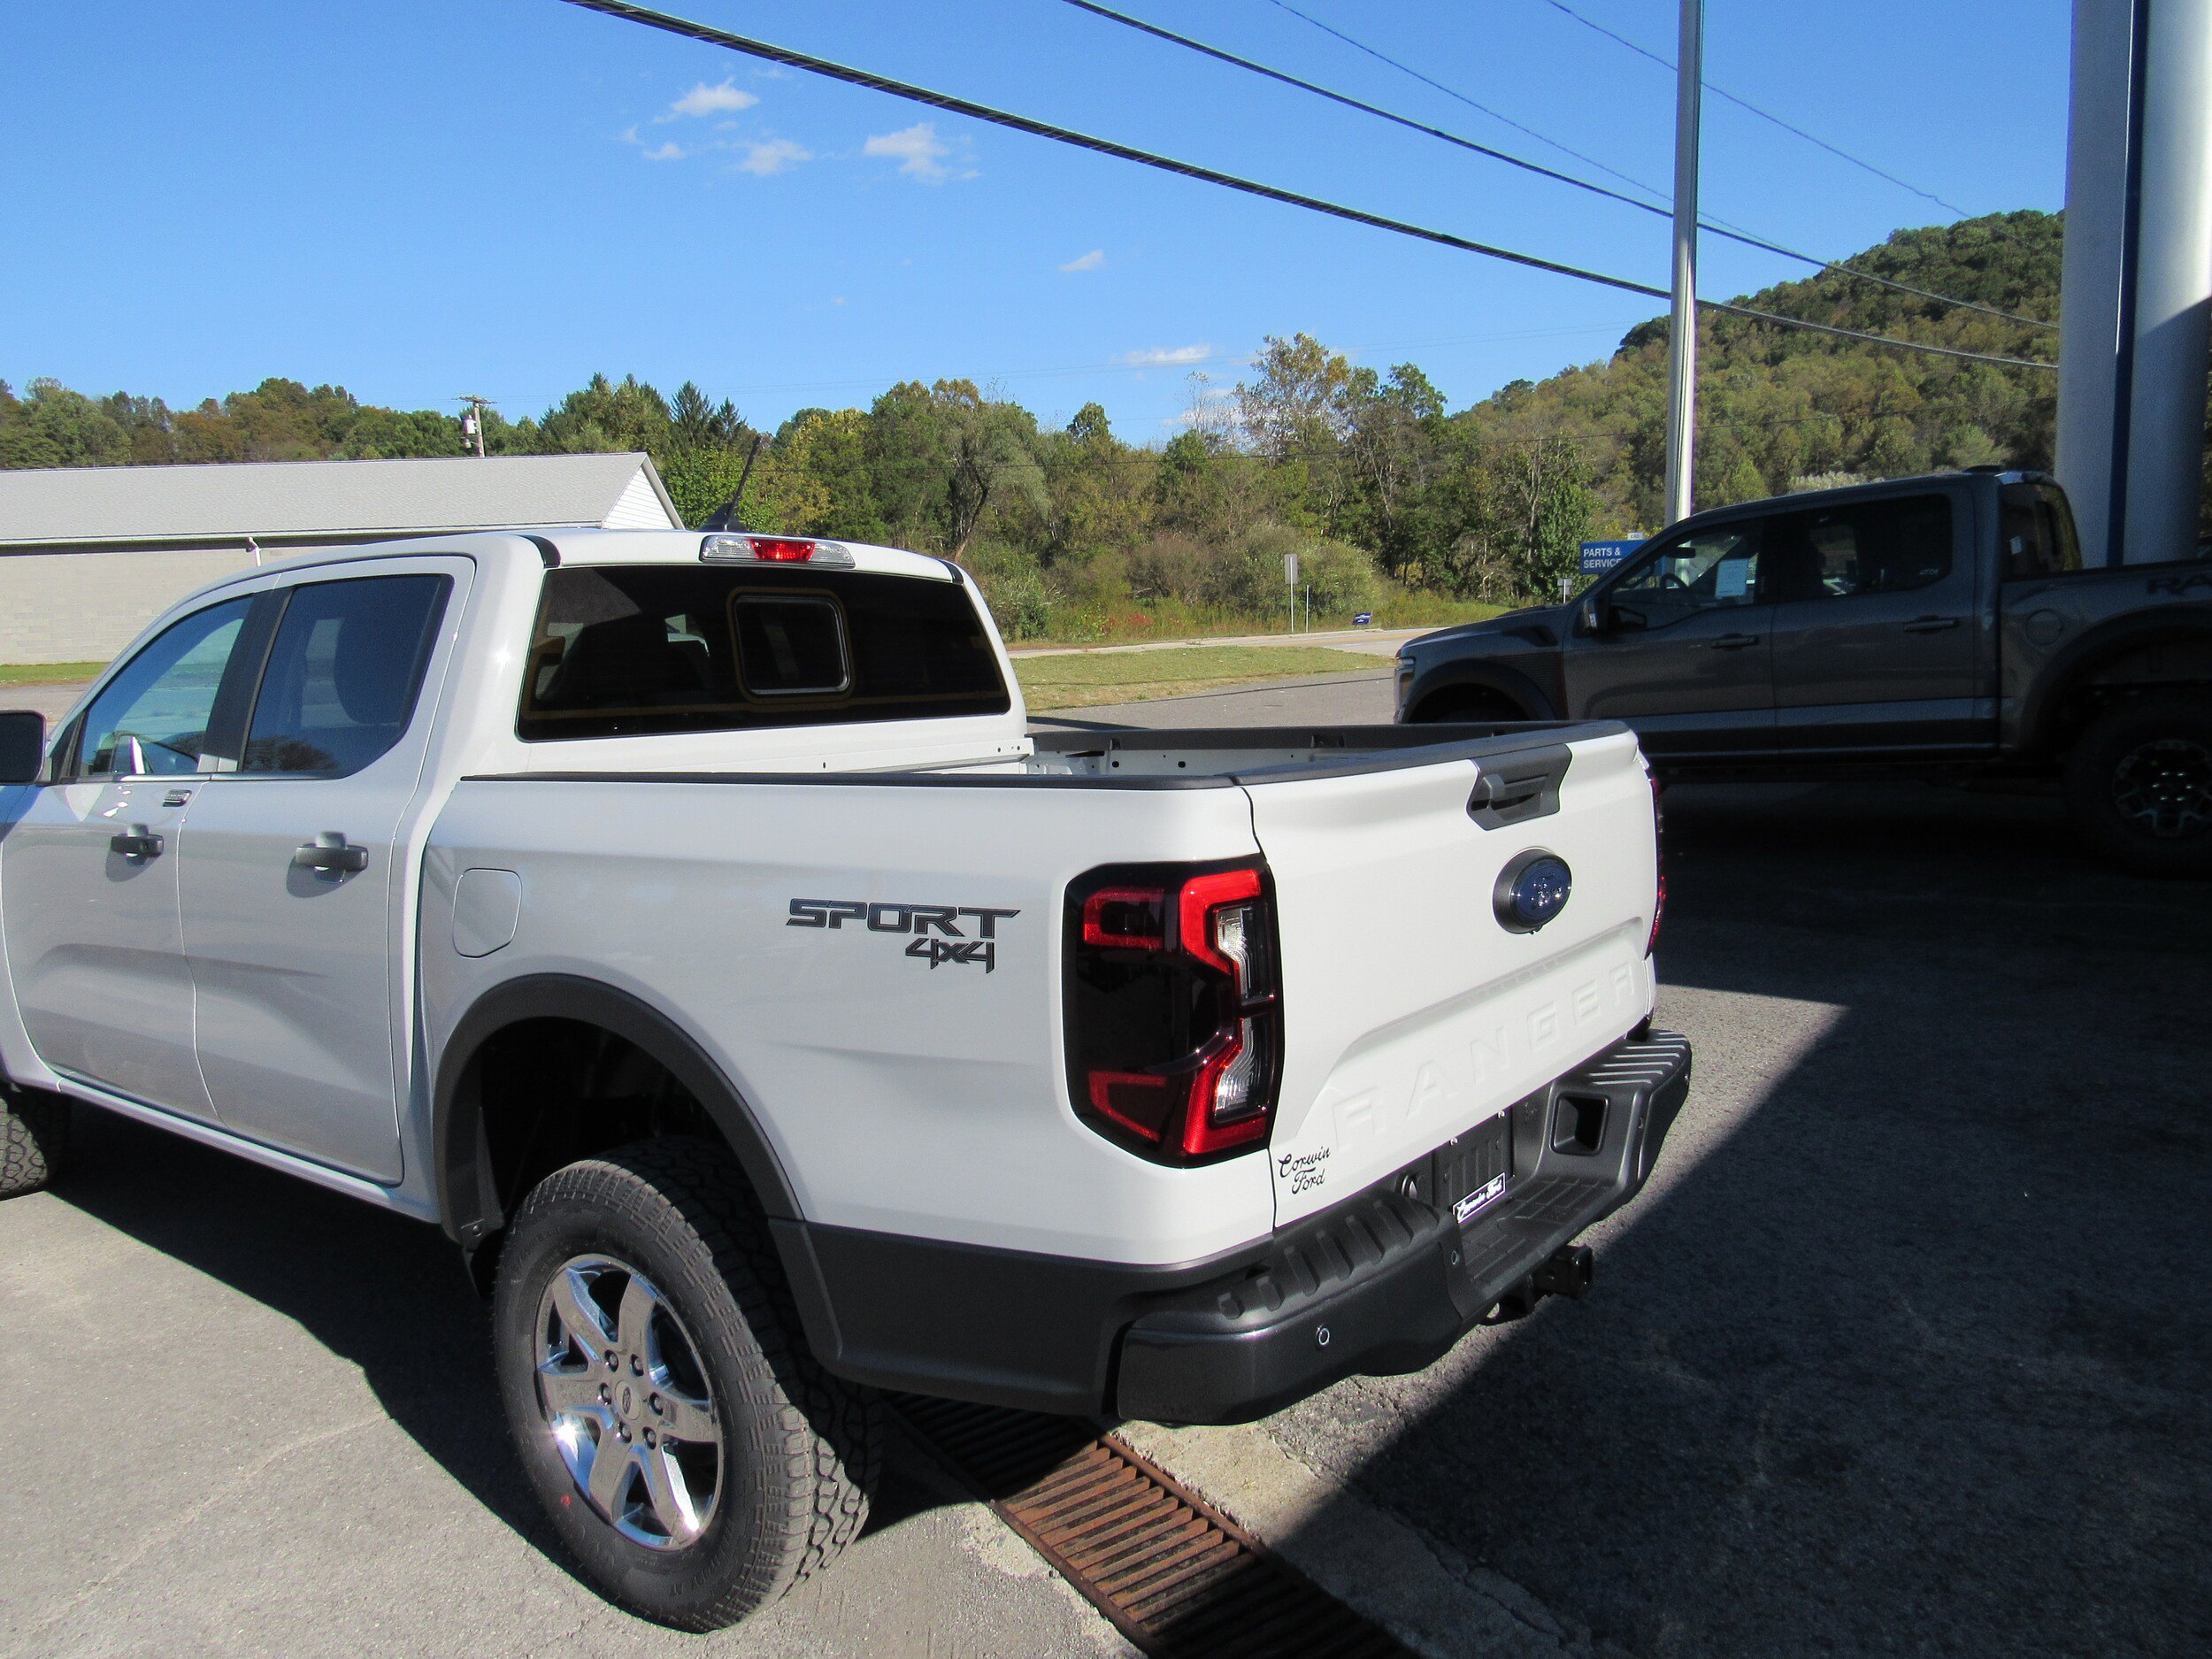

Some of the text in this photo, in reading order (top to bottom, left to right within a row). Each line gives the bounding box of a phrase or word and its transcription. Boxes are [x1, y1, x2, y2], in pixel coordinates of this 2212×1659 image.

[1584, 547, 1621, 557] PARTS &
[787, 898, 1021, 939] SPORT
[1332, 959, 1635, 1155] RANGER
[1278, 1146, 1331, 1178] Corwin
[1292, 1167, 1325, 1194] Ford
